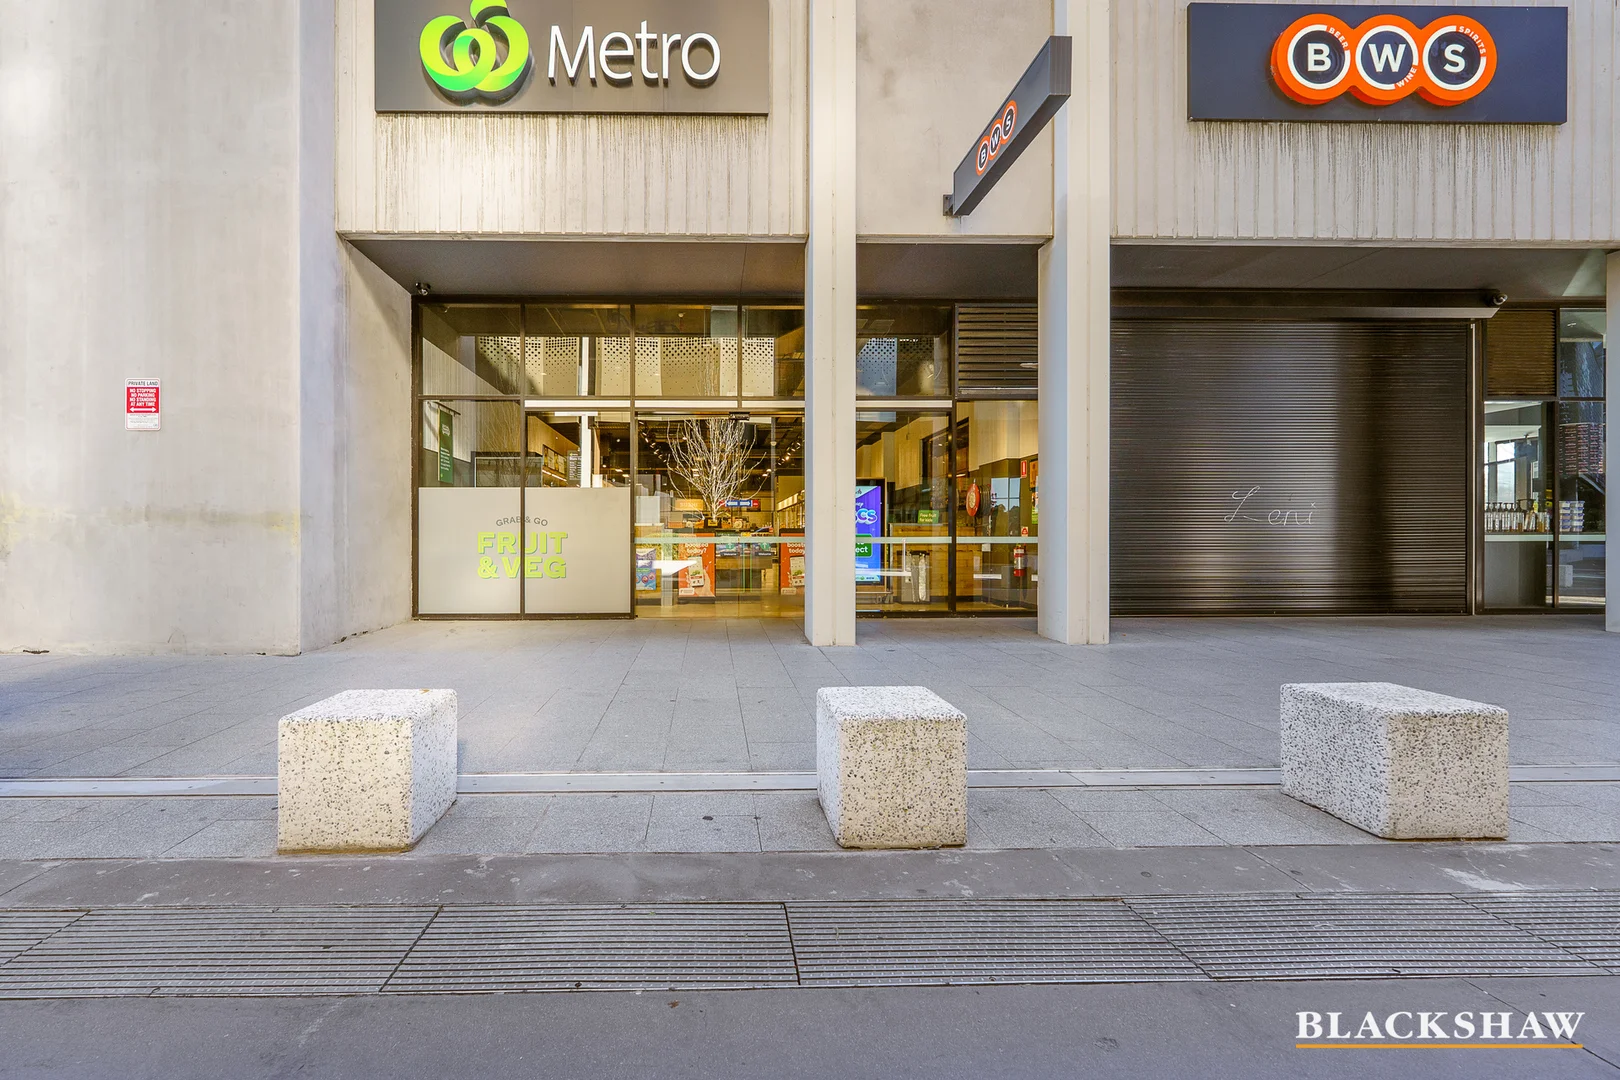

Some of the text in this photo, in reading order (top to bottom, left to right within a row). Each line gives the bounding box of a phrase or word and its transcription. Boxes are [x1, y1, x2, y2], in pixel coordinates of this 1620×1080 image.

[1328, 27, 1349, 49] BEER
[1458, 26, 1487, 54] SPIRITS
[548, 20, 721, 81] Metro
[1396, 67, 1417, 88] WINE
[981, 115, 1011, 163] BWS
[534, 517, 548, 526] GO
[478, 532, 568, 554] FRUIT
